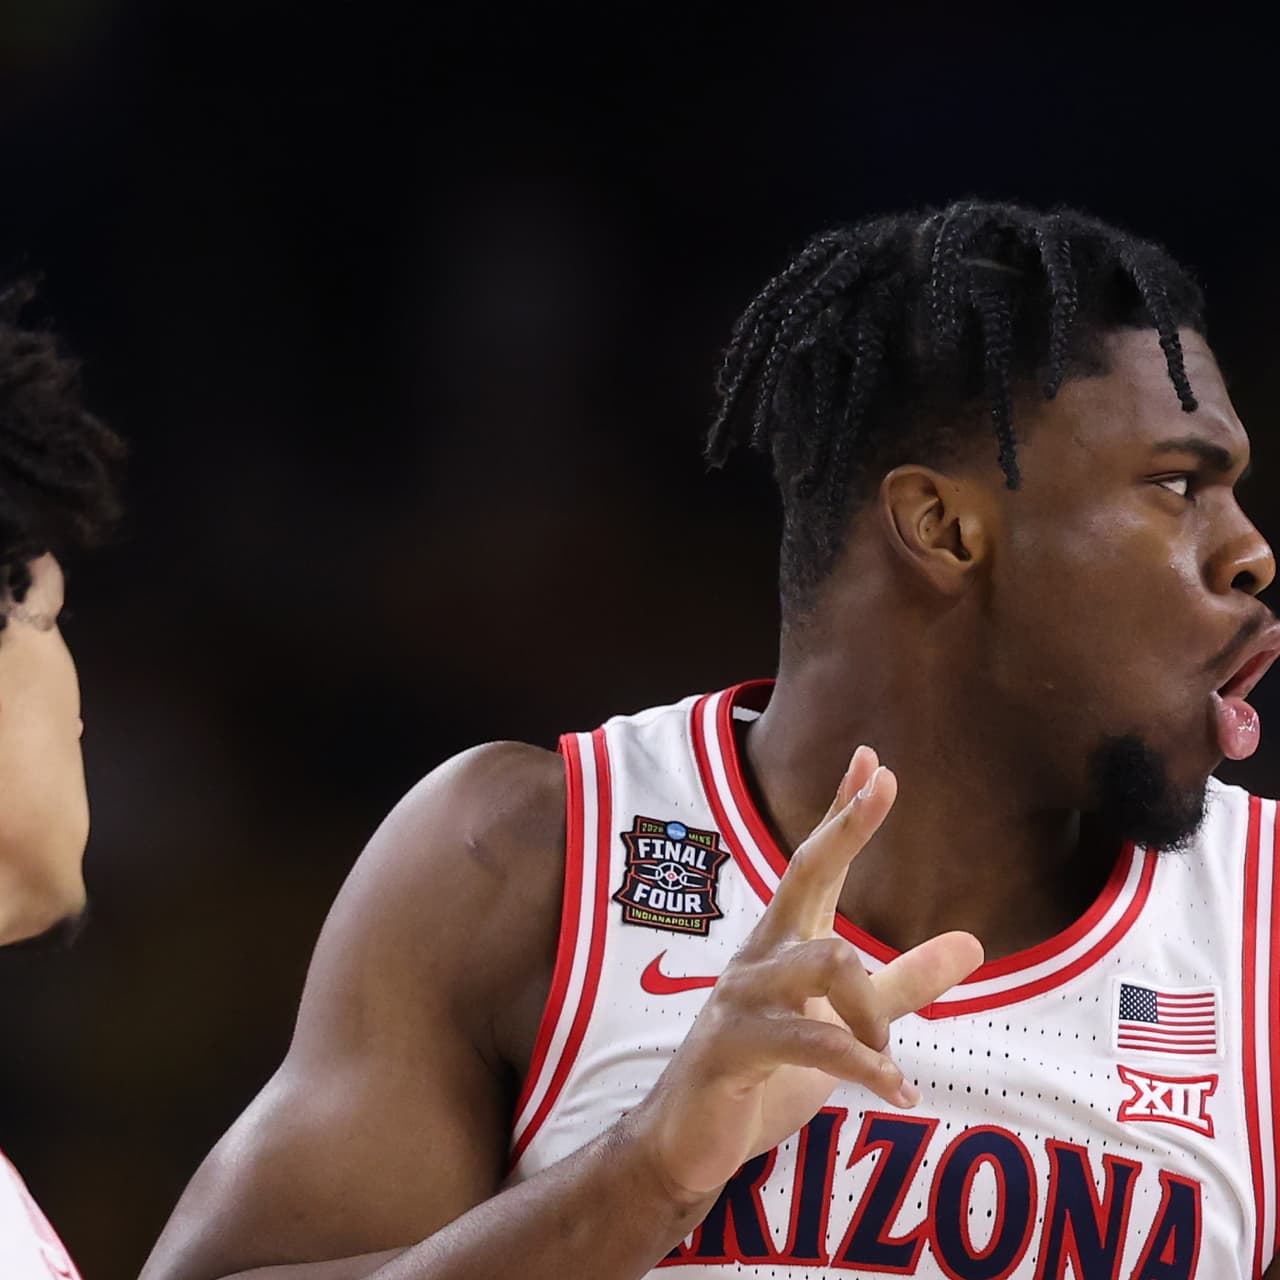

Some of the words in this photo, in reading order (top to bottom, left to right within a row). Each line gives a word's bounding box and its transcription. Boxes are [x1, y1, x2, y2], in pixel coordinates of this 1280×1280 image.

[637, 838, 707, 870] FINAL
[632, 882, 703, 913] FOUR
[631, 908, 701, 928] INDIANAPOLIS
